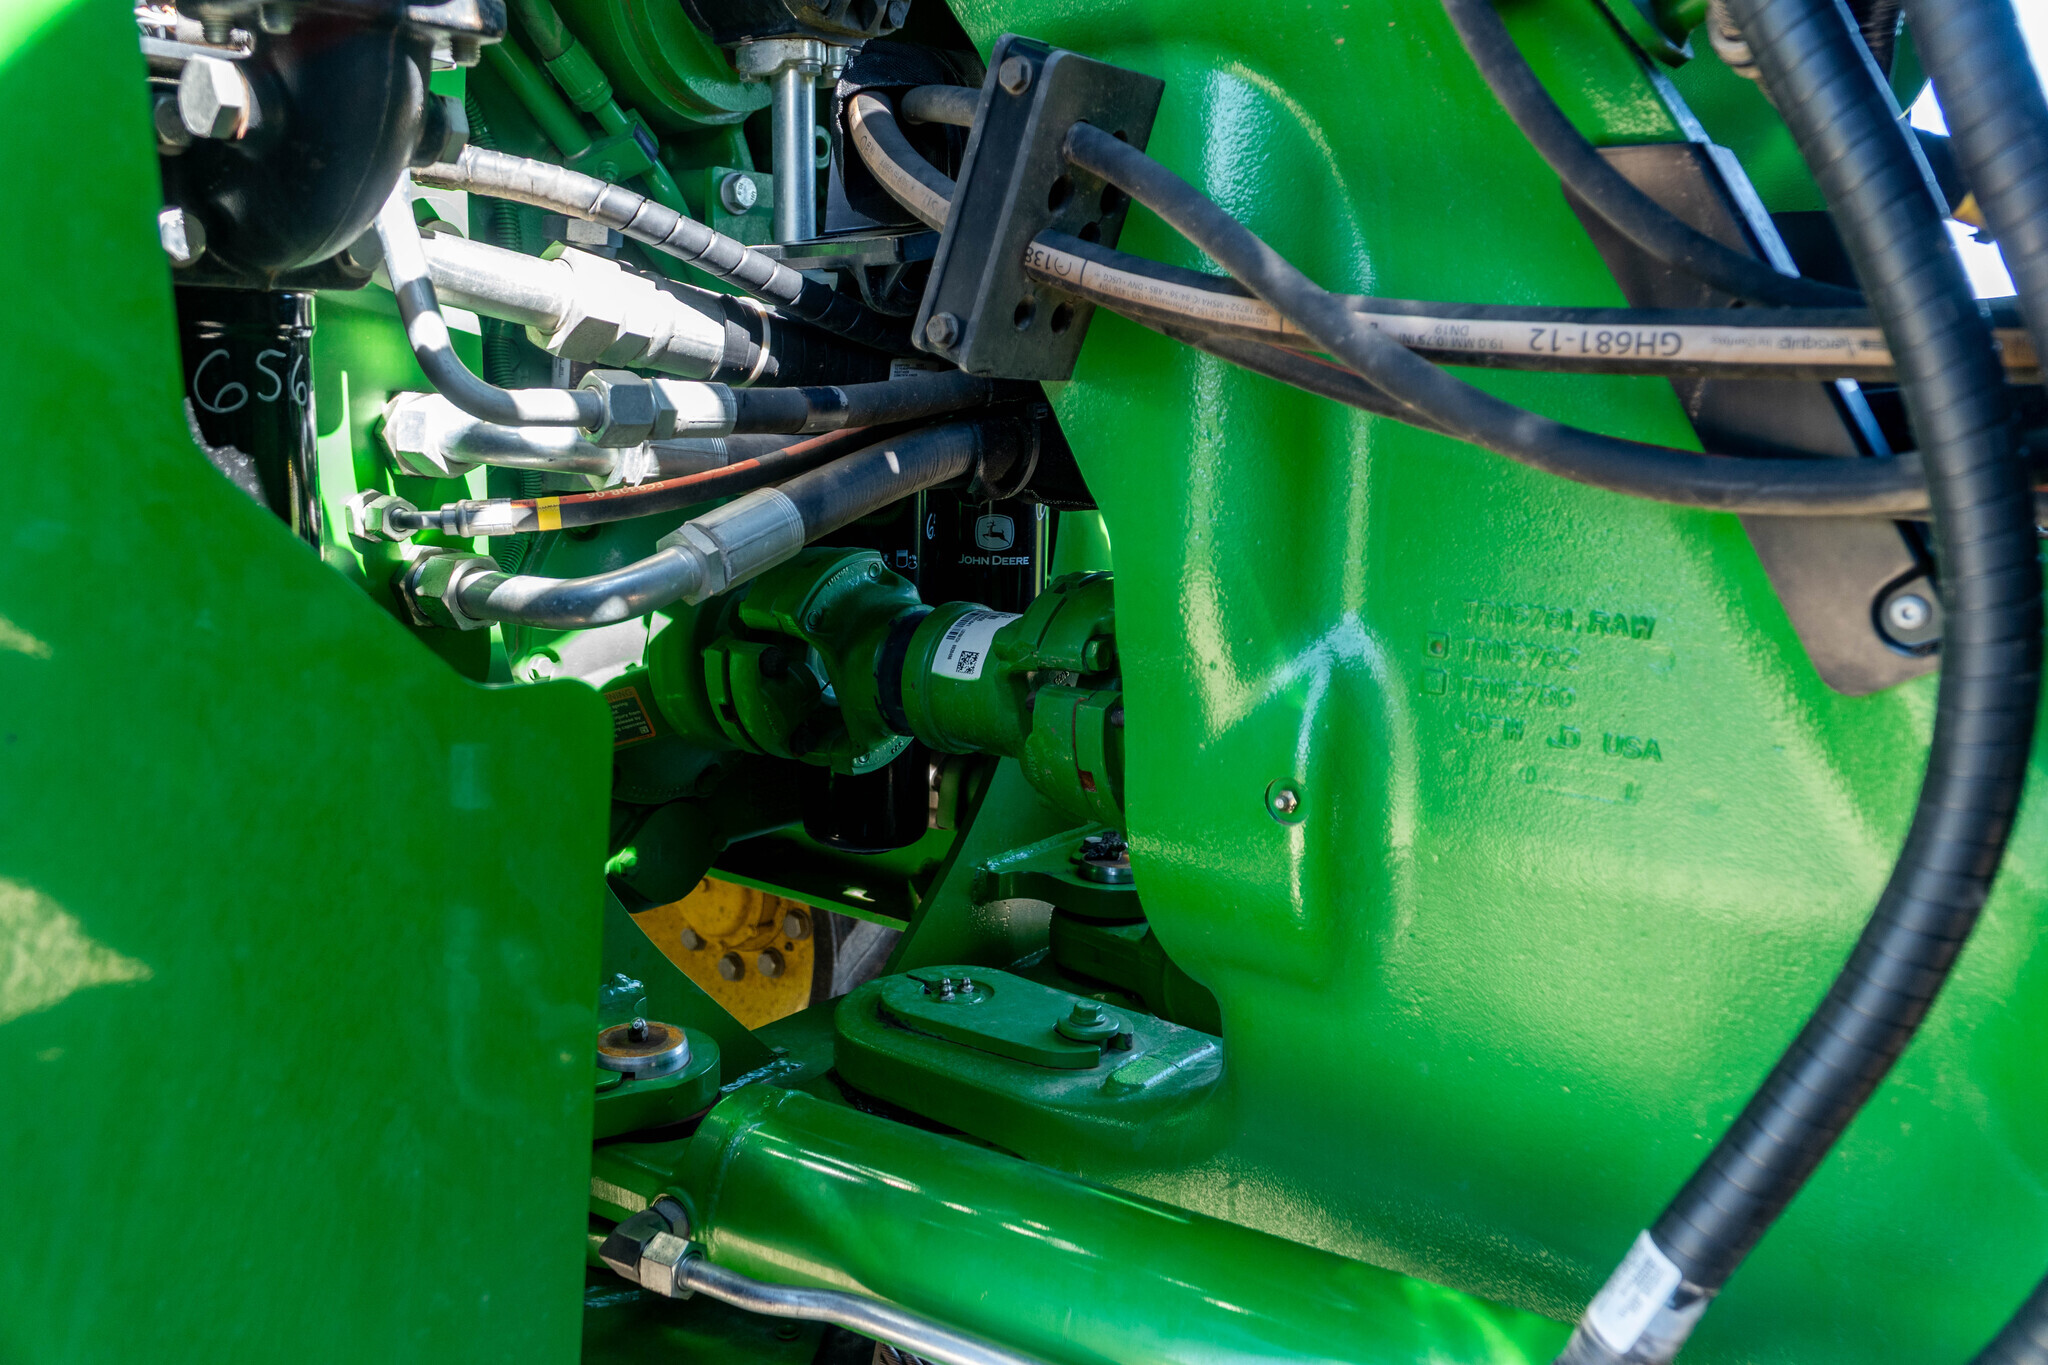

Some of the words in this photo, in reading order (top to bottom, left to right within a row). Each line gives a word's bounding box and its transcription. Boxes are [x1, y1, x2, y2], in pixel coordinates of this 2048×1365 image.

[1025, 247, 1050, 270] 138
[1103, 273, 1122, 284] USCG
[1128, 281, 1143, 290] DNV
[1149, 285, 1164, 295] ABS
[1434, 325, 1469, 336] DN19
[1529, 328, 1682, 356] GH681-12
[957, 554, 990, 566] JOHN
[992, 555, 1030, 566] DEERE
[1602, 732, 1664, 762] USA
